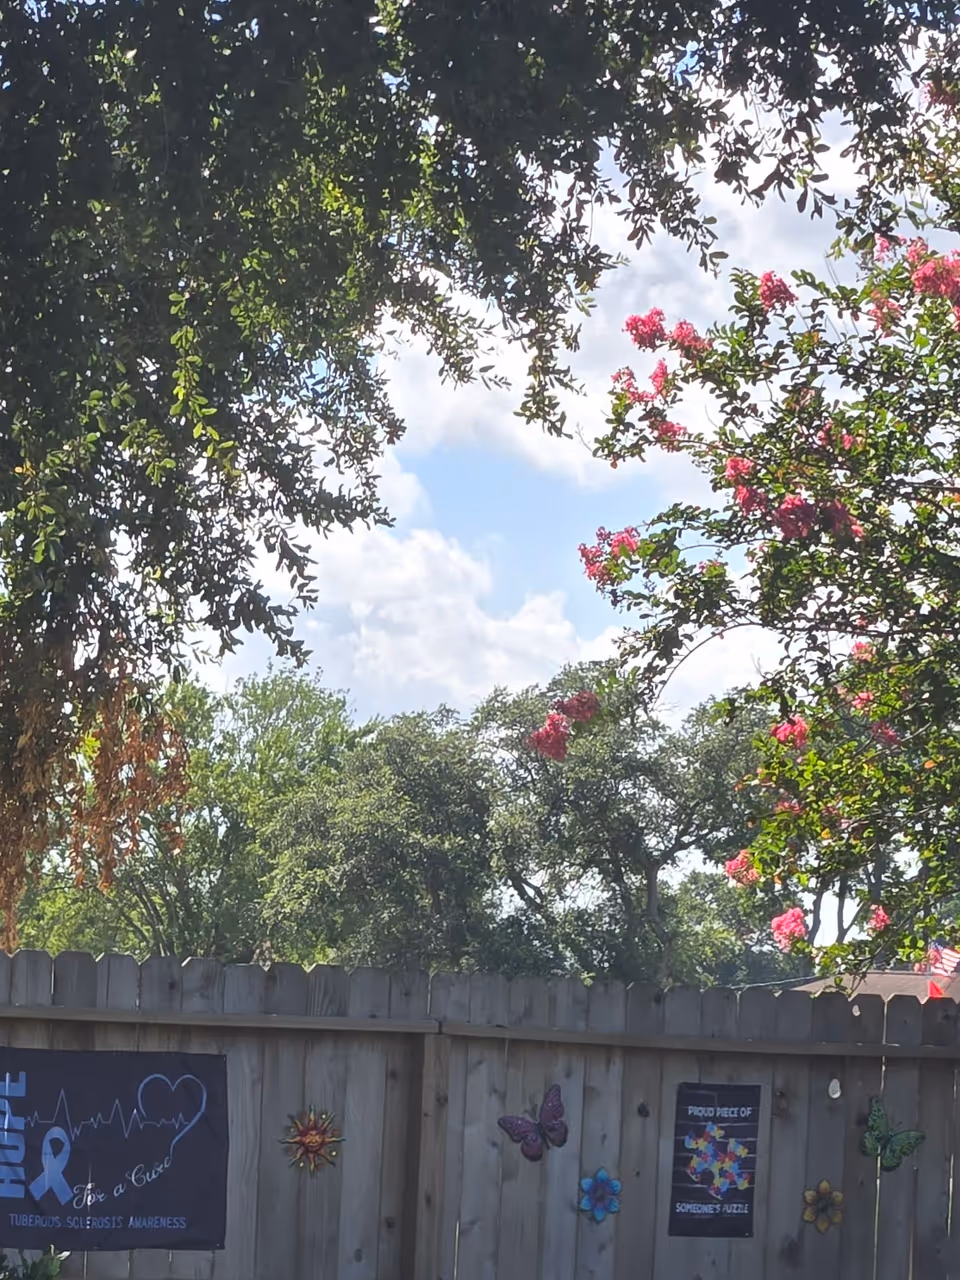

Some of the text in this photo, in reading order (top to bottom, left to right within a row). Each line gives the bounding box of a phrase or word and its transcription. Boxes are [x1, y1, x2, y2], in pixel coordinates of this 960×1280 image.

[688, 1105, 752, 1117] PROUD PIECE OF
[73, 1156, 172, 1209] For a Cure
[675, 1202, 749, 1214] SOMEONE'S PUZZLE
[8, 1213, 187, 1230] TUBEROUS SCLEROSIS AWARENESS
